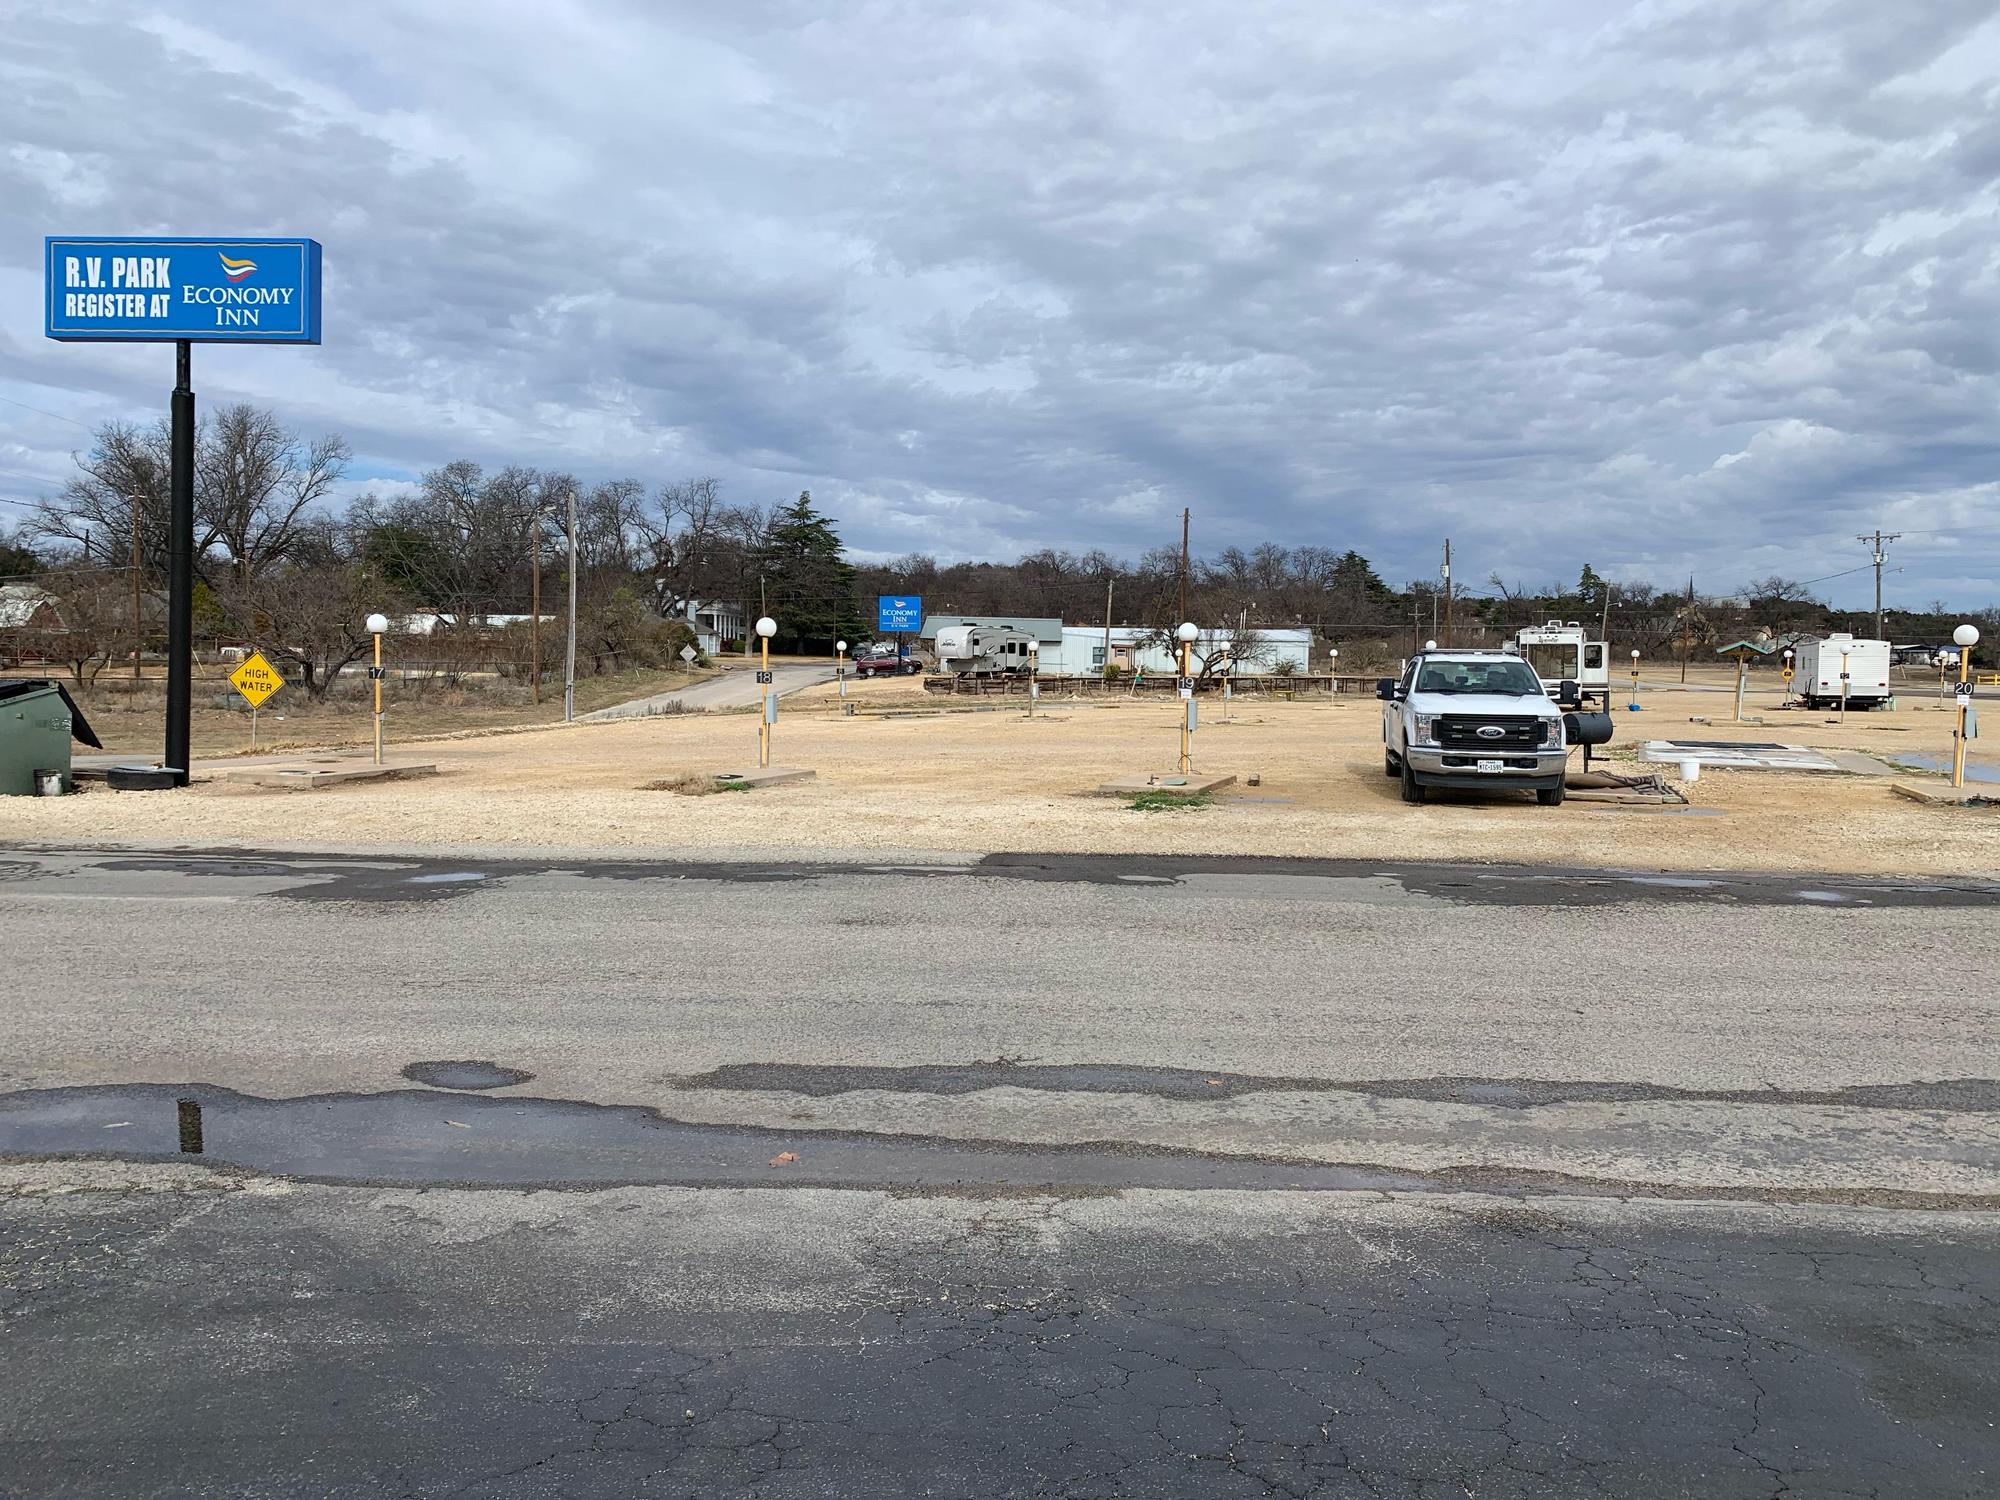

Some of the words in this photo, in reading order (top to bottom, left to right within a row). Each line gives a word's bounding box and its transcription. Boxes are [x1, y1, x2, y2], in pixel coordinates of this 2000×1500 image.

[66, 257, 106, 288] R.V.
[112, 257, 170, 288] PARK
[182, 285, 294, 304] ECONOMY
[66, 293, 146, 317] REGISTER
[150, 294, 170, 318] AT
[215, 306, 259, 326] INN
[245, 669, 269, 679] HIGH
[370, 667, 384, 678] 17
[758, 672, 771, 683] 18
[240, 681, 273, 692] WATER
[1180, 677, 1194, 688] 19
[1955, 682, 1973, 694] 20
